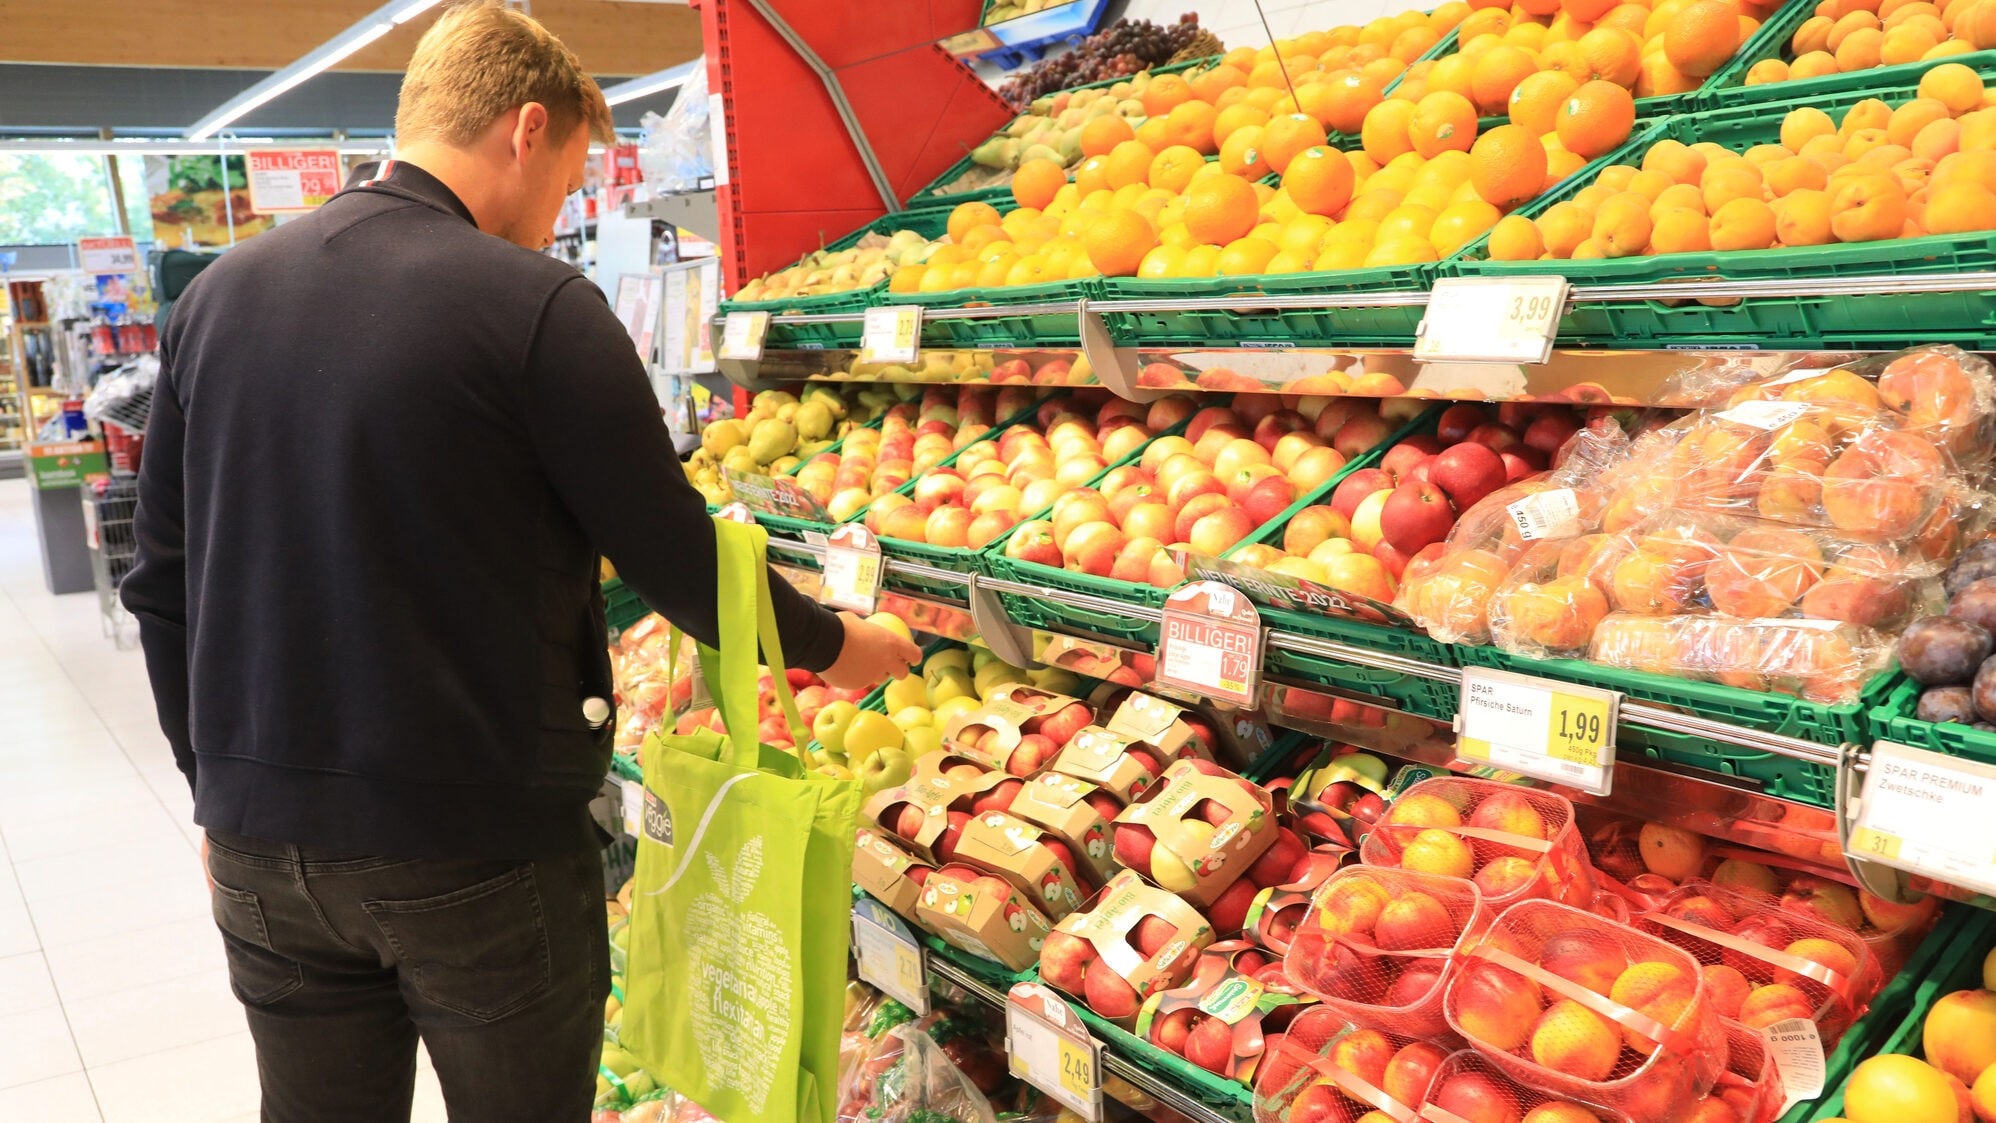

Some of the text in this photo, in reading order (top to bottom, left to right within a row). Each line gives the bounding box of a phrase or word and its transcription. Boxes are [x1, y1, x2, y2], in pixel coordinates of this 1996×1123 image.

[252, 155, 336, 169] BILLIGER!
[1510, 296, 1551, 324] 3,99
[1516, 510, 1530, 529] 450
[1195, 567, 1353, 611] NEUE ERNTE 2022
[1169, 621, 1252, 654] BILLIGER!
[1222, 656, 1248, 678] 1.79
[1471, 683, 1494, 696] SPAR
[1470, 695, 1533, 717] Pfirsiche Saturn
[1559, 709, 1600, 744] 1,99
[1879, 778, 1944, 804] Zwetschke
[1884, 763, 1984, 798] SPAR PREMIUM
[645, 803, 672, 837] veggie
[1871, 836, 1889, 855] 31
[870, 904, 897, 932] BIO
[1781, 1033, 1806, 1042] 1000
[1064, 1051, 1089, 1085] 2,49
